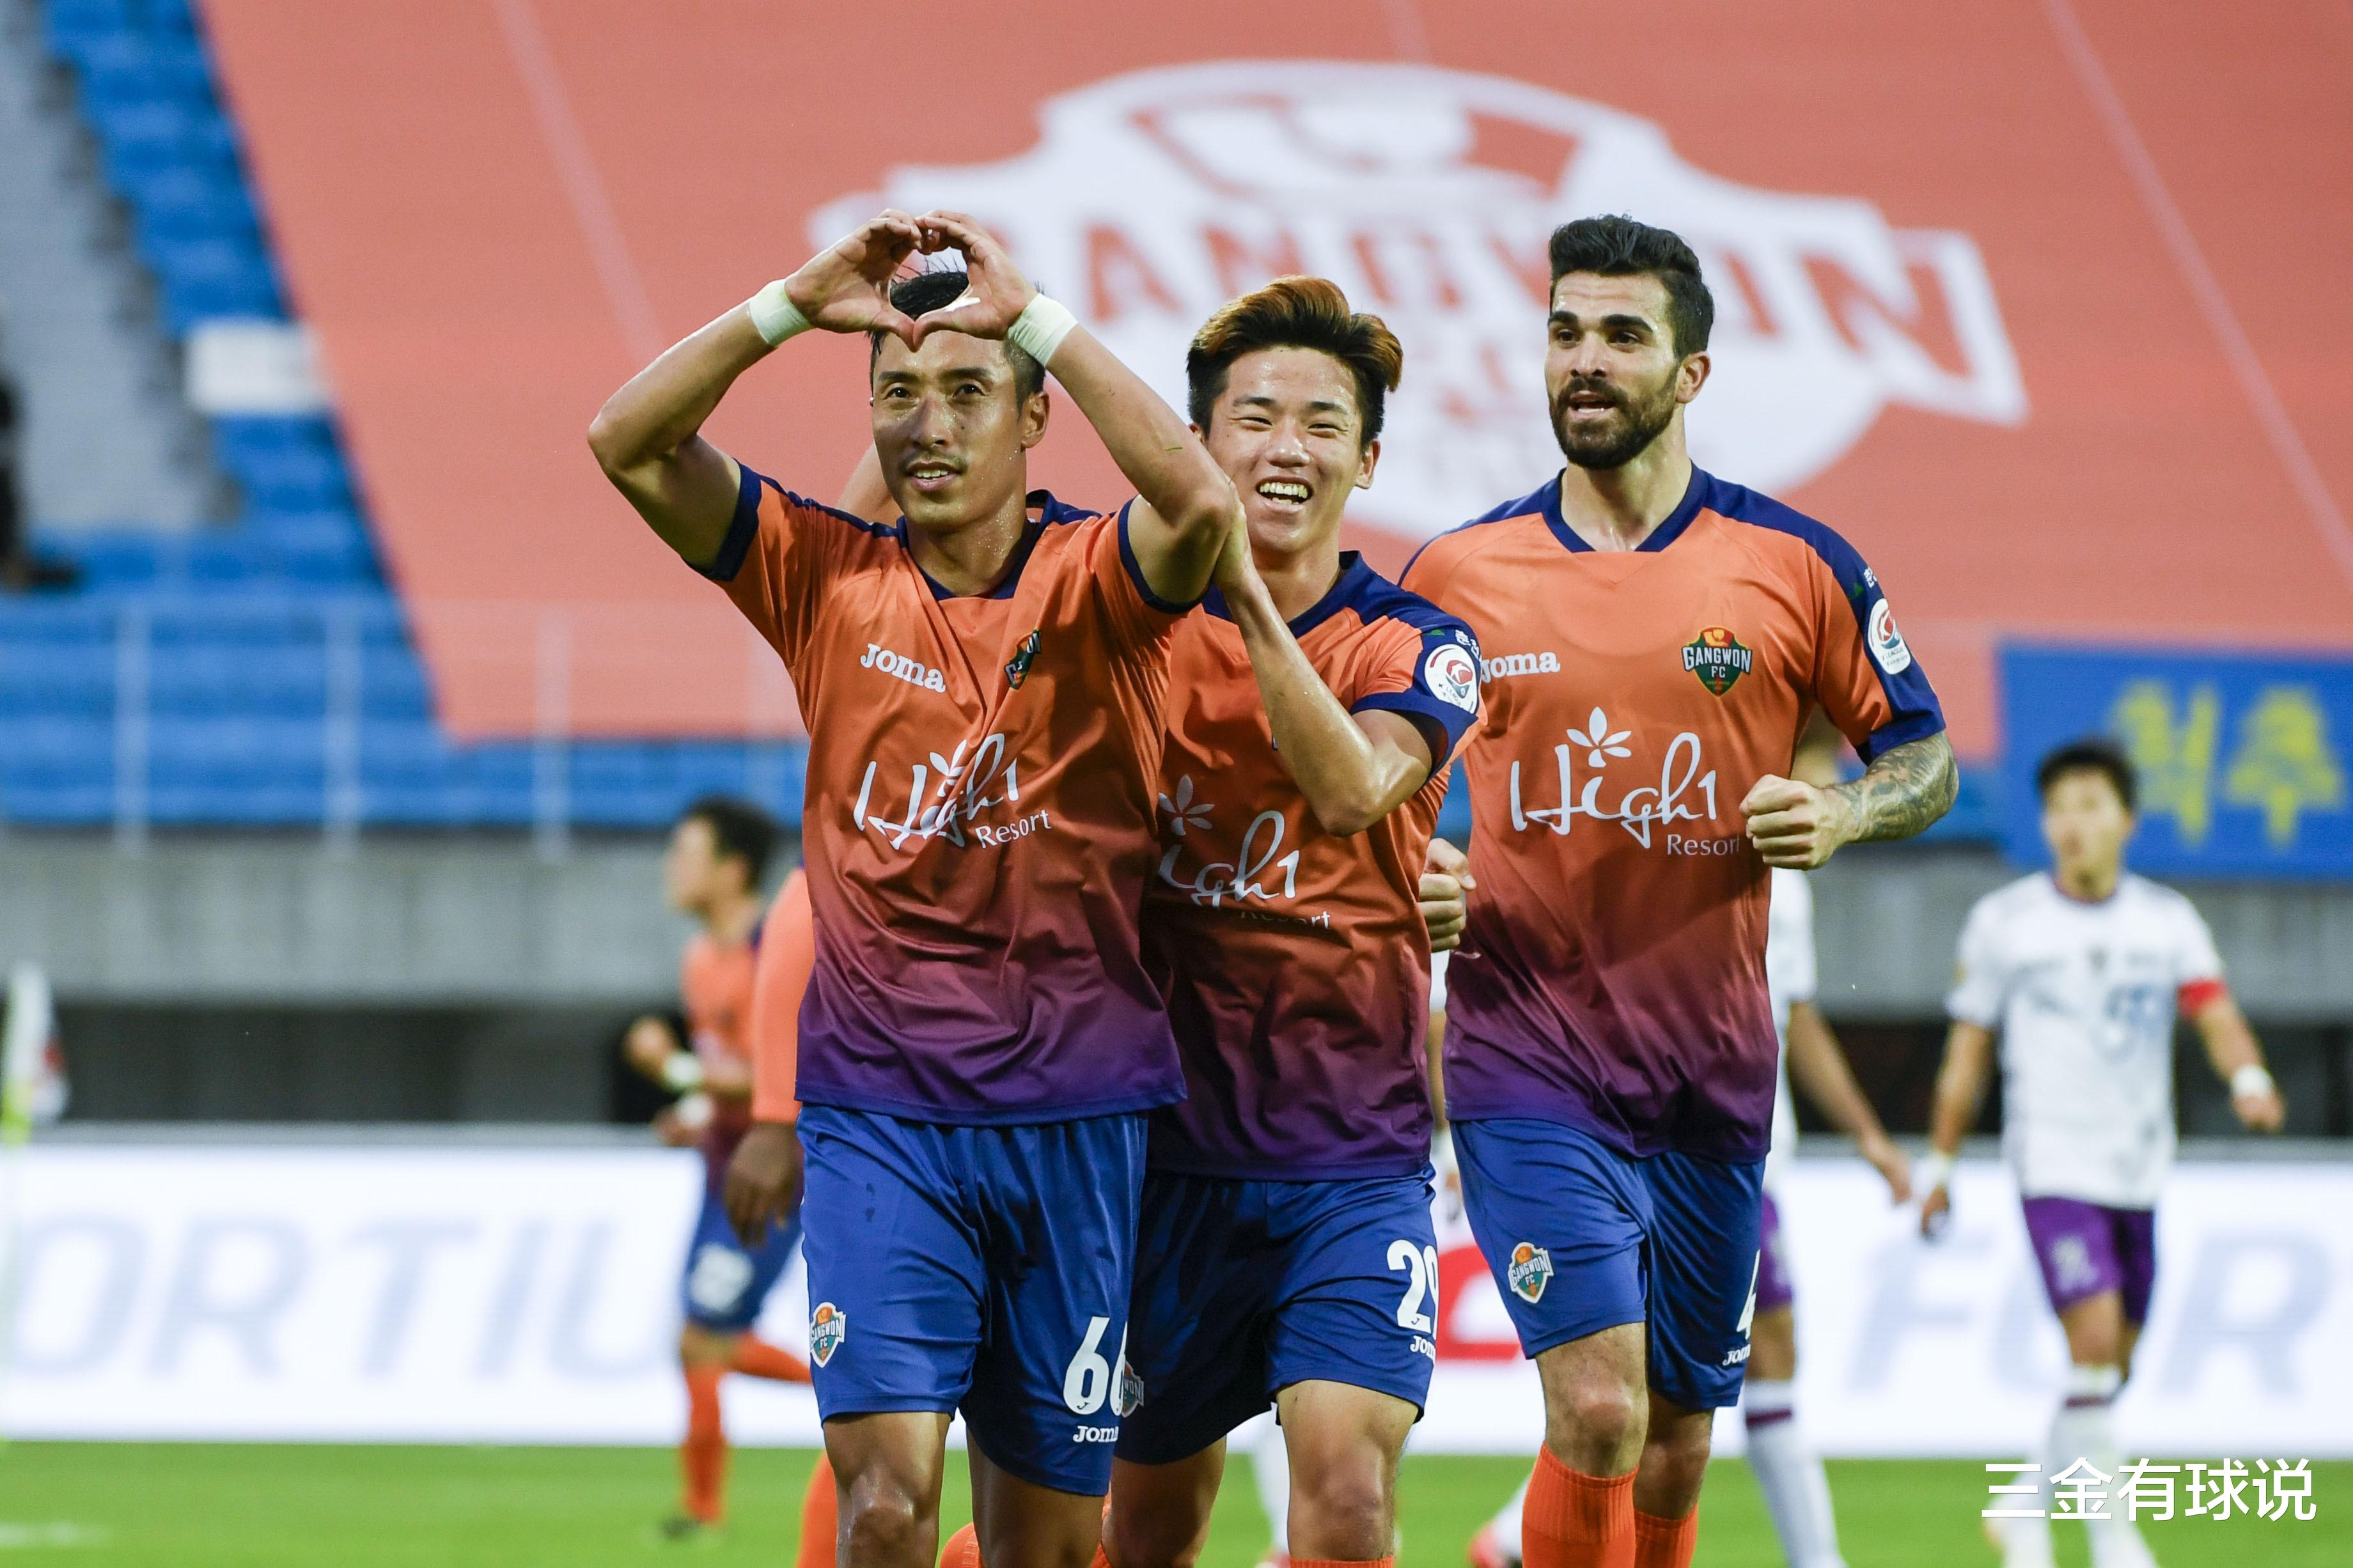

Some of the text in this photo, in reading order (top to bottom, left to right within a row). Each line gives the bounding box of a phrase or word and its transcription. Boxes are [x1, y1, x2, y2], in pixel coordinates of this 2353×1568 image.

[1682, 646, 1752, 673] GANGWON
[1711, 665, 1726, 678] FC
[975, 809, 1052, 849] Resort
[1511, 1254, 1550, 1288] GANGWON
[1524, 1274, 1535, 1285] FC
[809, 1317, 843, 1349] GANGWON
[820, 1337, 828, 1349] FC
